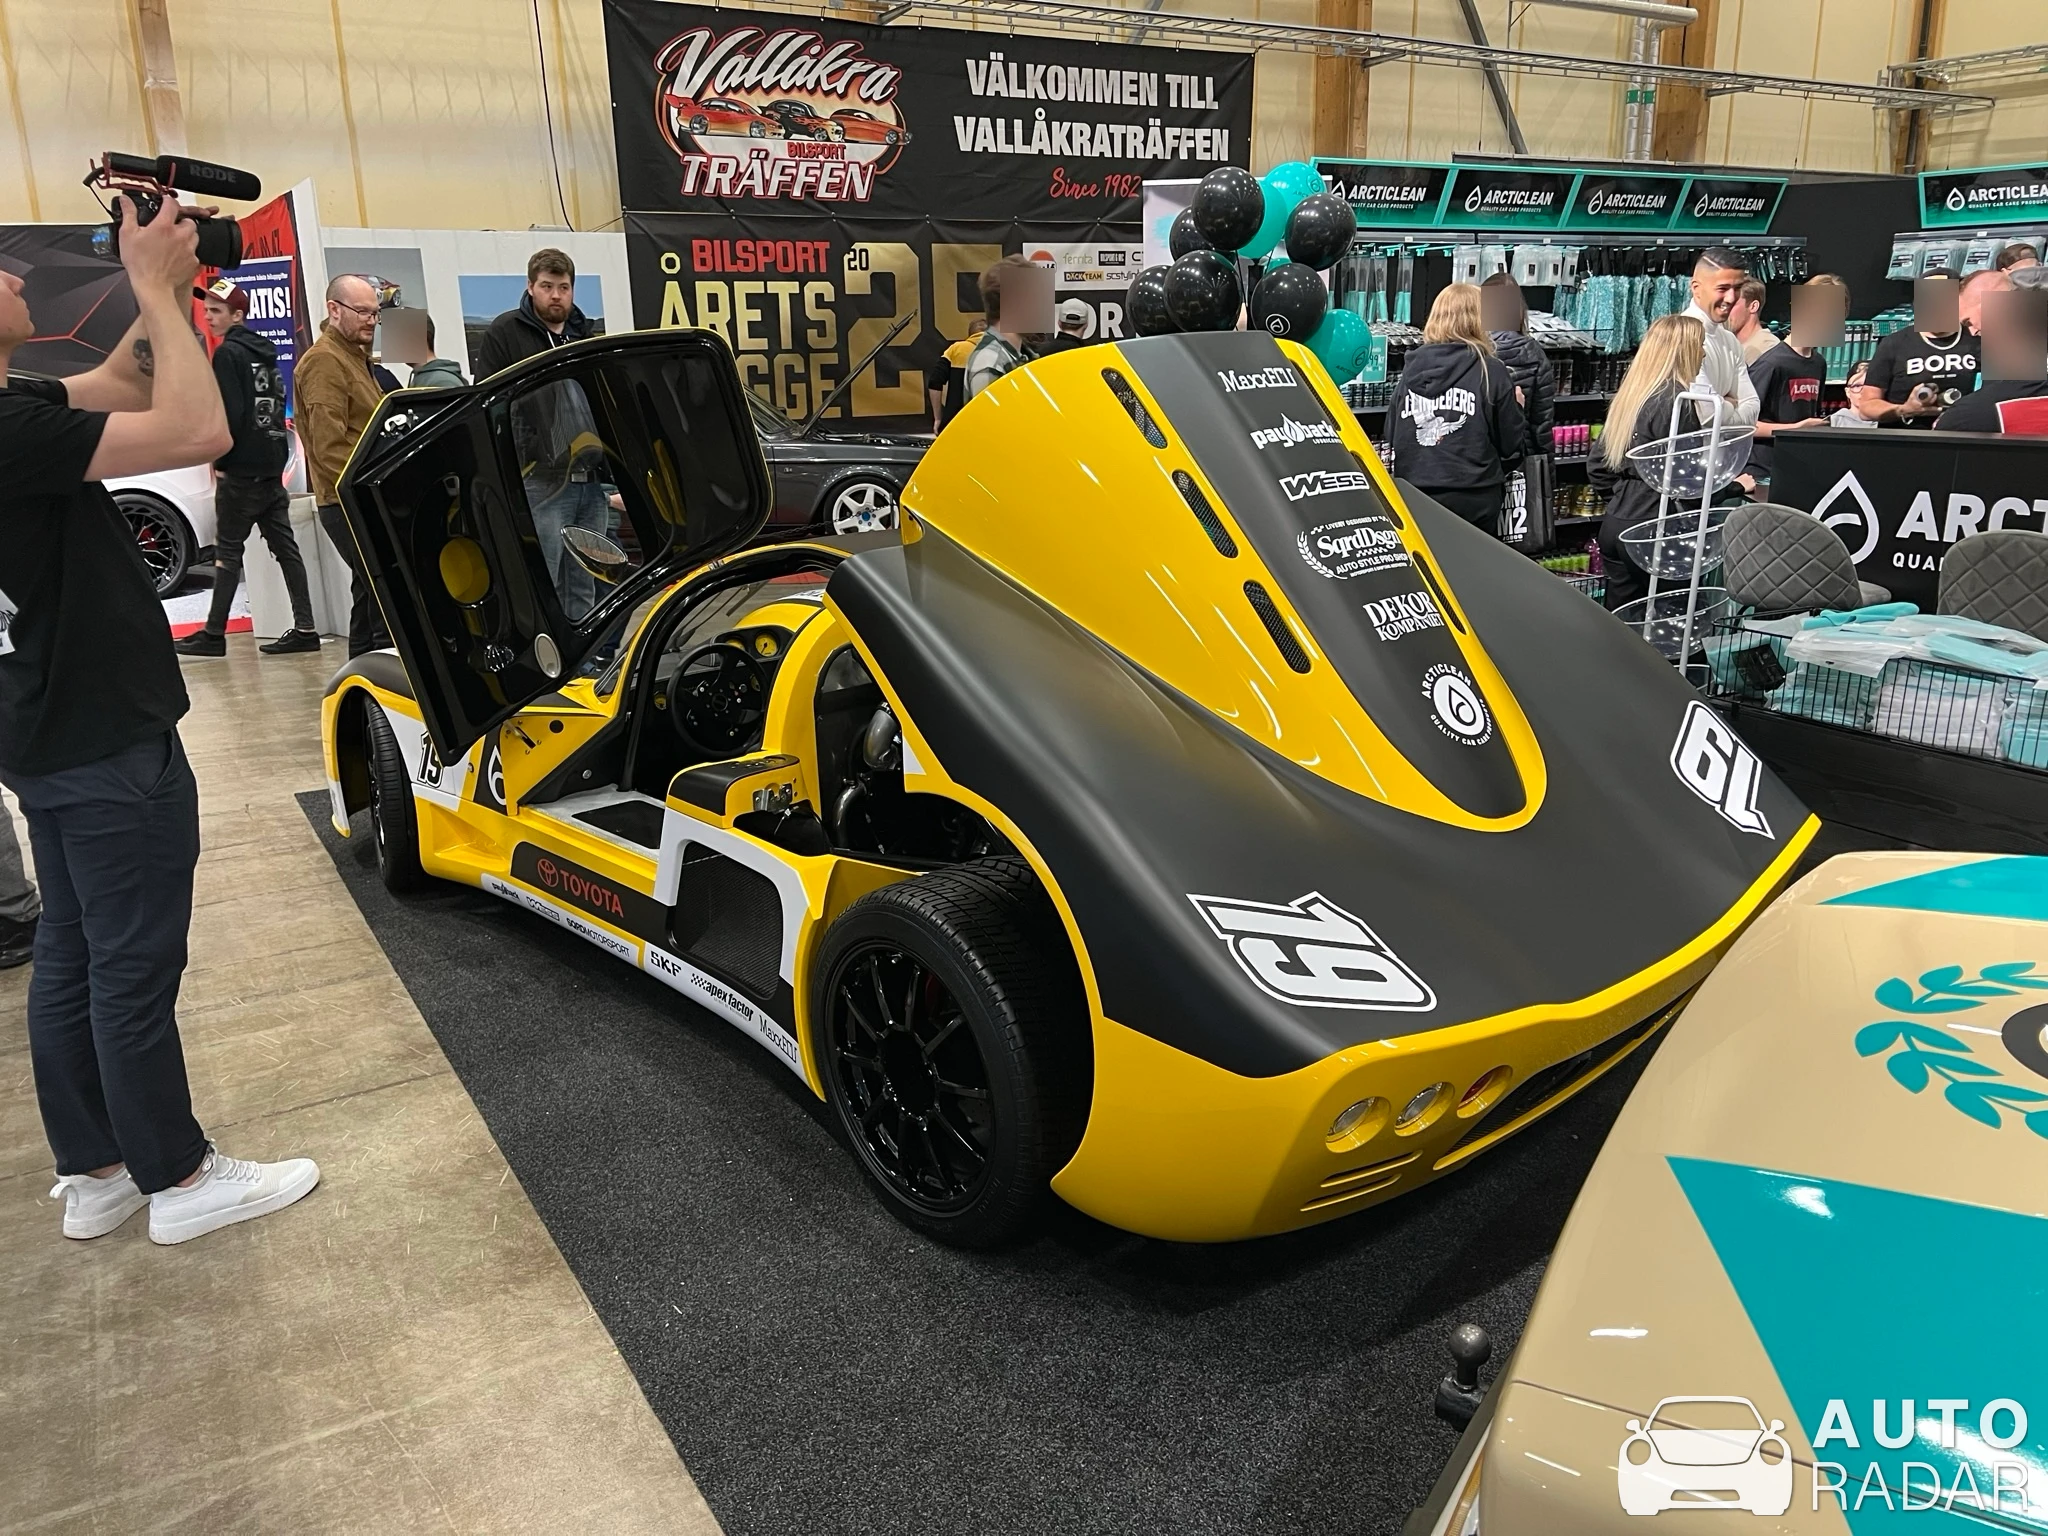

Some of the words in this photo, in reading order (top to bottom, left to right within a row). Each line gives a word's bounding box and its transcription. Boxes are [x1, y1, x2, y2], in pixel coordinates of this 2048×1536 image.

[655, 28, 900, 103] Vallåkra
[966, 52, 1158, 106] VÄLKOMMEN
[1165, 74, 1219, 110] TILL
[954, 107, 1229, 162] VALLÅKRATRÄFFEN
[787, 142, 846, 160] BILSPORT
[682, 150, 875, 200] TRÄFFEN
[1050, 166, 1101, 200] Since
[1104, 174, 1142, 198] 1982
[1348, 185, 1426, 201] ARCTICLEAN
[1483, 190, 1554, 205] ARCTICLEAN
[1604, 194, 1666, 208] ARCTICLEAN
[1709, 197, 1765, 211] ARCTICLEAN
[692, 239, 830, 273] BILSPORT
[849, 249, 869, 270] 20
[247, 287, 291, 319] ATIS!
[660, 252, 837, 350] ÅRETS
[1907, 354, 1976, 374] BORG
[1501, 490, 1526, 509] MW
[1325, 521, 1345, 530] LIVERY
[1497, 507, 1528, 536] M2
[1317, 527, 1402, 558] SqrdDsgn
[1336, 561, 1359, 575] AUTO
[1357, 556, 1380, 569] STYLE
[1380, 553, 1395, 563] PRO
[1363, 591, 1438, 627] DEKOR
[1375, 613, 1445, 641] KOMPANIET
[1421, 663, 1471, 699] ARCTICLEAN
[1430, 714, 1460, 742] QUALITY
[1462, 738, 1476, 746] CAR
[560, 869, 624, 918] TOYOTA
[650, 951, 681, 977] SKF
[1186, 891, 1438, 1013] 19
[706, 981, 727, 1002] apex
[727, 993, 754, 1022] factor
